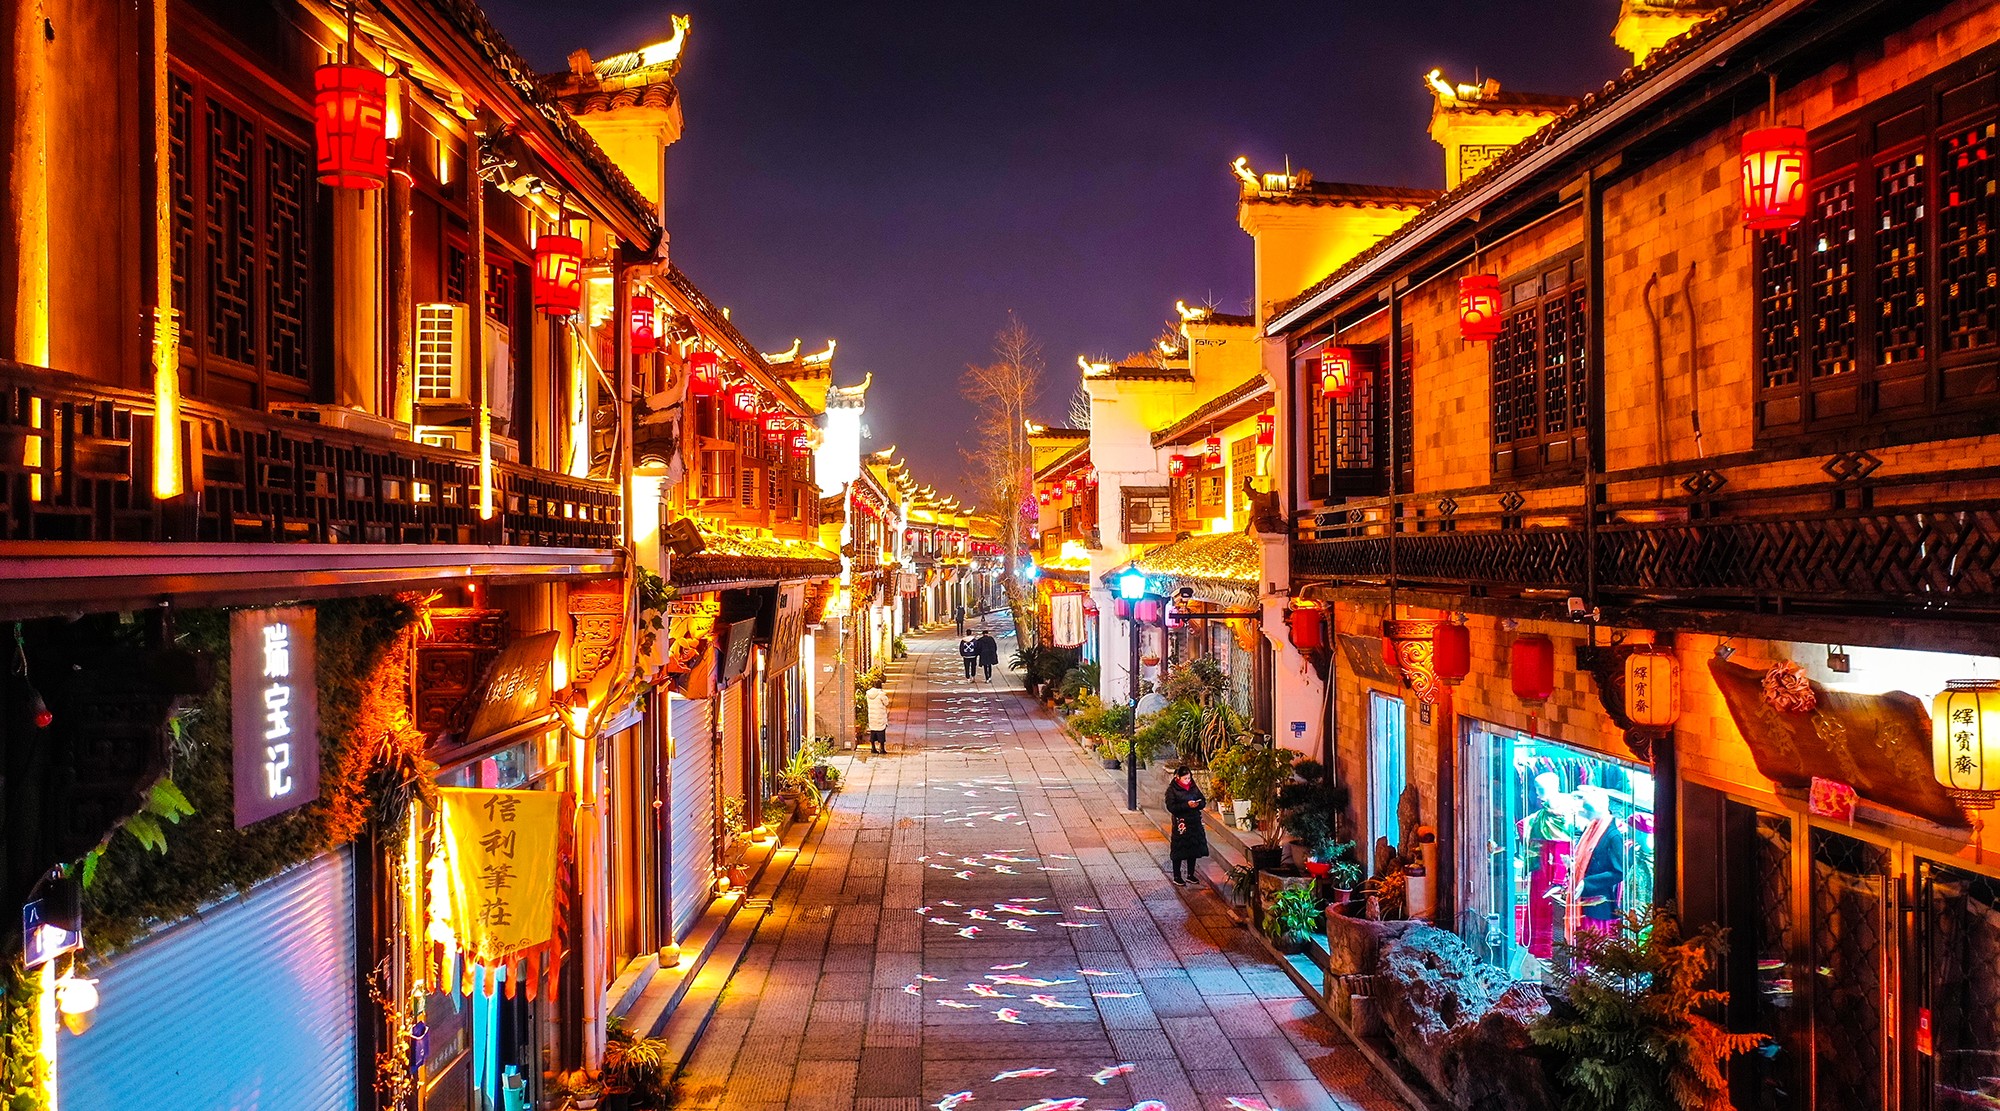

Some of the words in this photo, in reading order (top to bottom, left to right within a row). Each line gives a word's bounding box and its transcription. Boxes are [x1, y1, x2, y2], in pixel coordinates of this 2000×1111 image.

[263, 622, 292, 799] 瑞宝记
[1952, 707, 1978, 776] 繹寶齋
[476, 794, 522, 928] 信利筆莊
